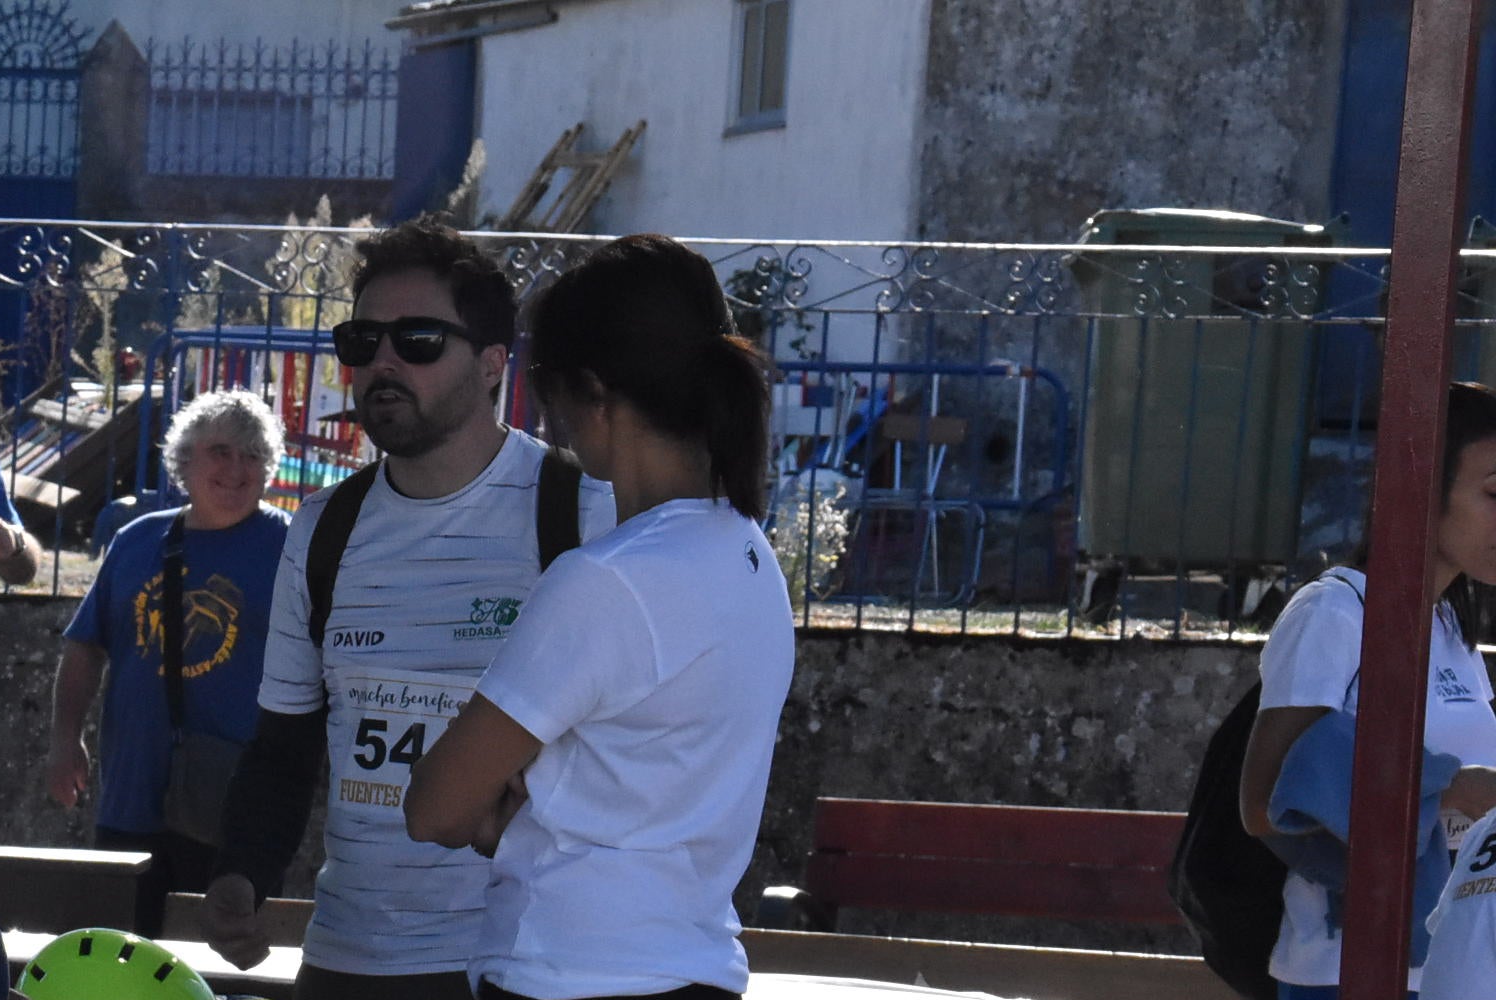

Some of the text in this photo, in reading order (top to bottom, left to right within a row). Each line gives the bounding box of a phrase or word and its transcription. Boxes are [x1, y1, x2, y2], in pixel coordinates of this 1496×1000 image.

[333, 630, 385, 648] DAVID
[453, 626, 502, 638] HEDASA
[339, 779, 402, 807] FUENTES
